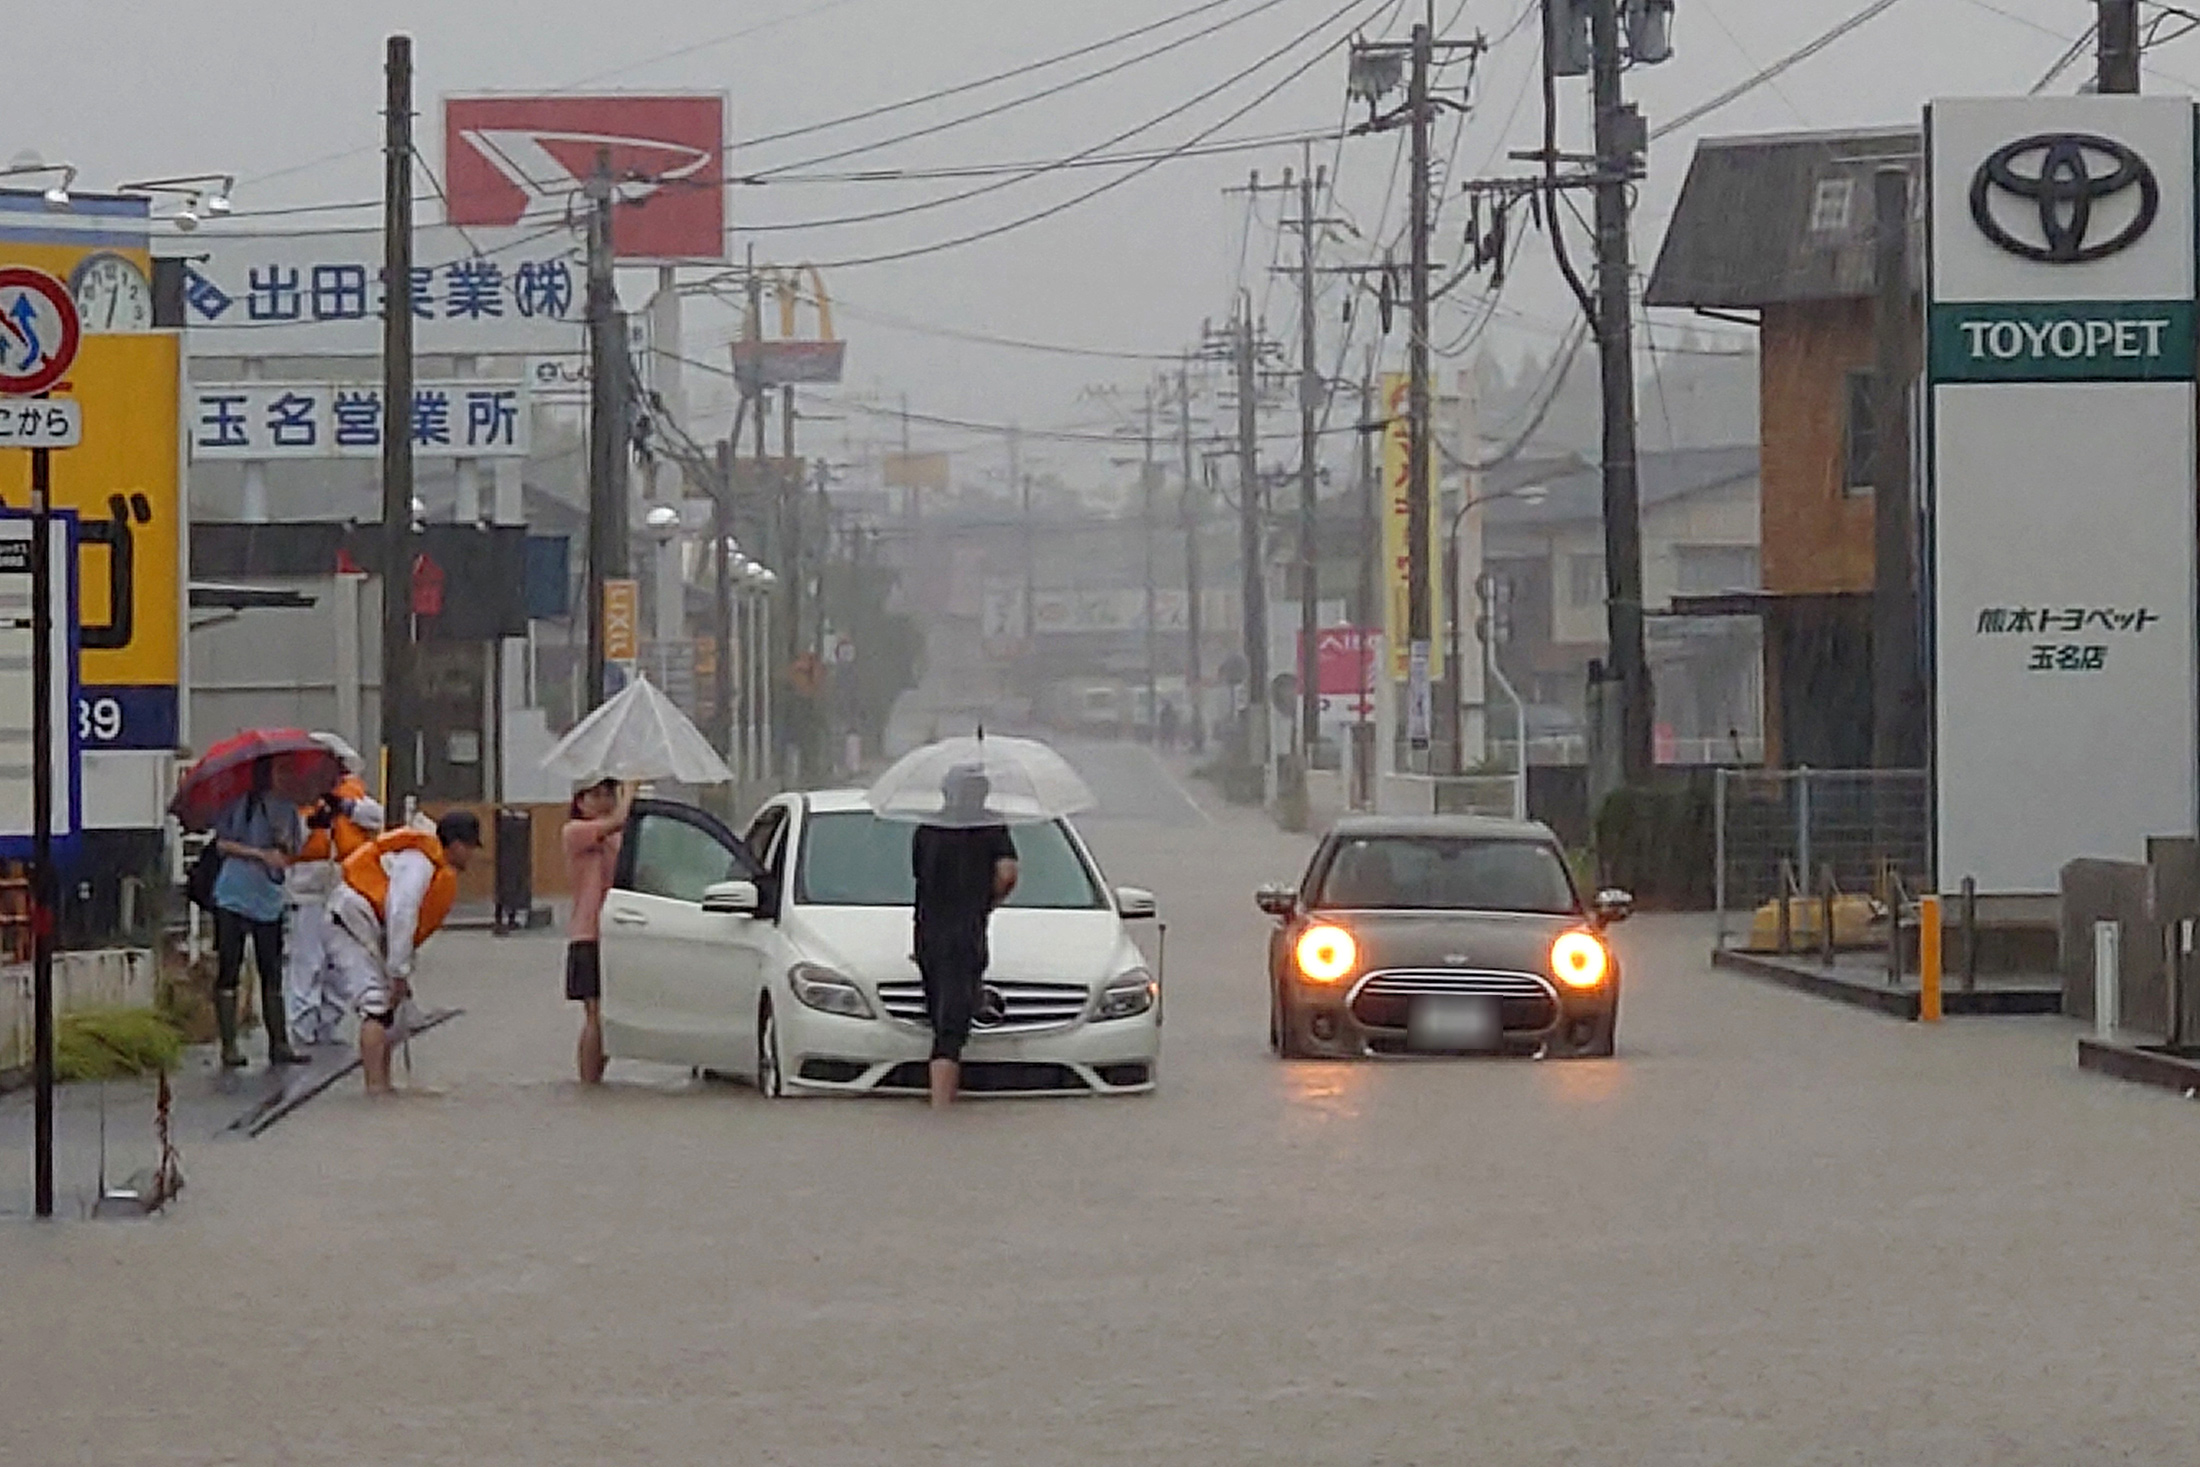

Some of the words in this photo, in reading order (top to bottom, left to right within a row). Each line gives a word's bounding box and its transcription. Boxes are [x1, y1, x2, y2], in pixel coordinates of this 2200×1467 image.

[1960, 319, 2170, 358] TOYOPET
[198, 390, 518, 446] 玉名営業所
[1976, 607, 2160, 634] 熊本トヨペット
[2028, 644, 2109, 671] 玉名店
